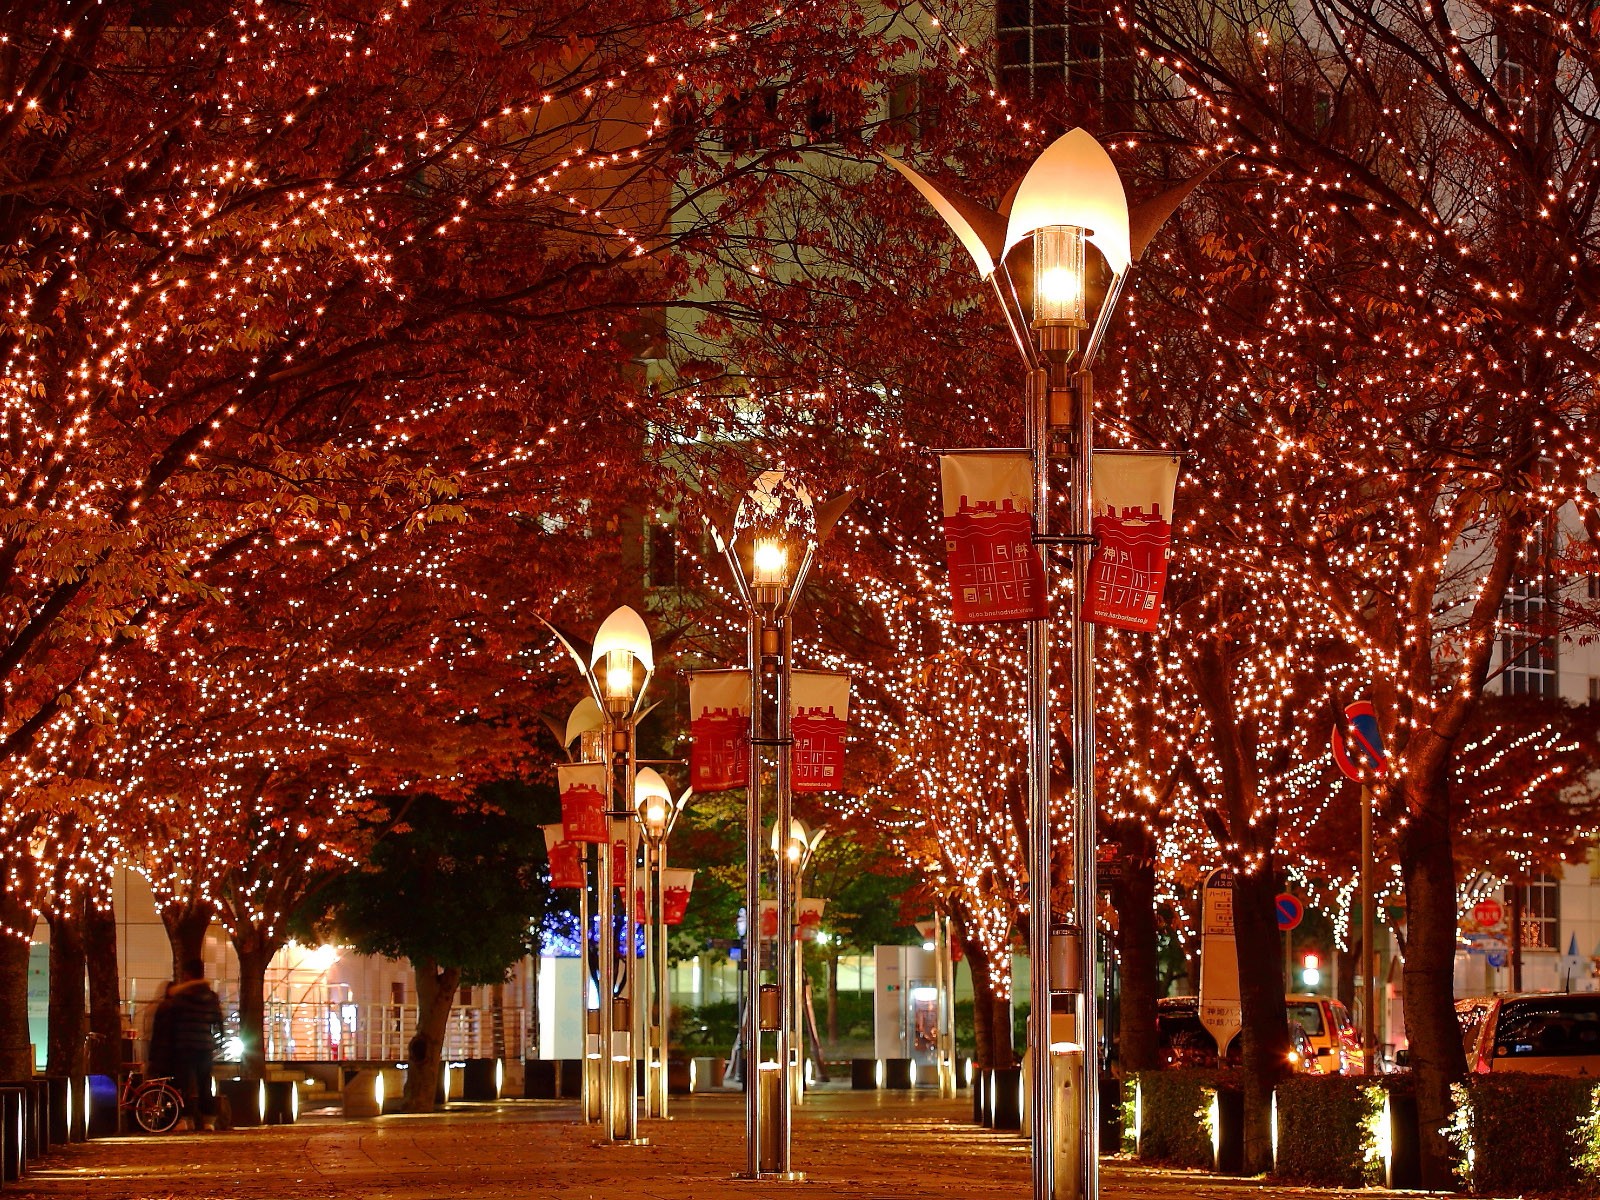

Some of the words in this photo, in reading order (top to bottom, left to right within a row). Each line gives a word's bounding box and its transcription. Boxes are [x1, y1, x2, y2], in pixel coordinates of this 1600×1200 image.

[1103, 546, 1128, 563] 神戸
[1101, 565, 1158, 587] ハーバー
[1099, 585, 1141, 607] ランド
[1094, 610, 1148, 624] www.harborland.co.jp
